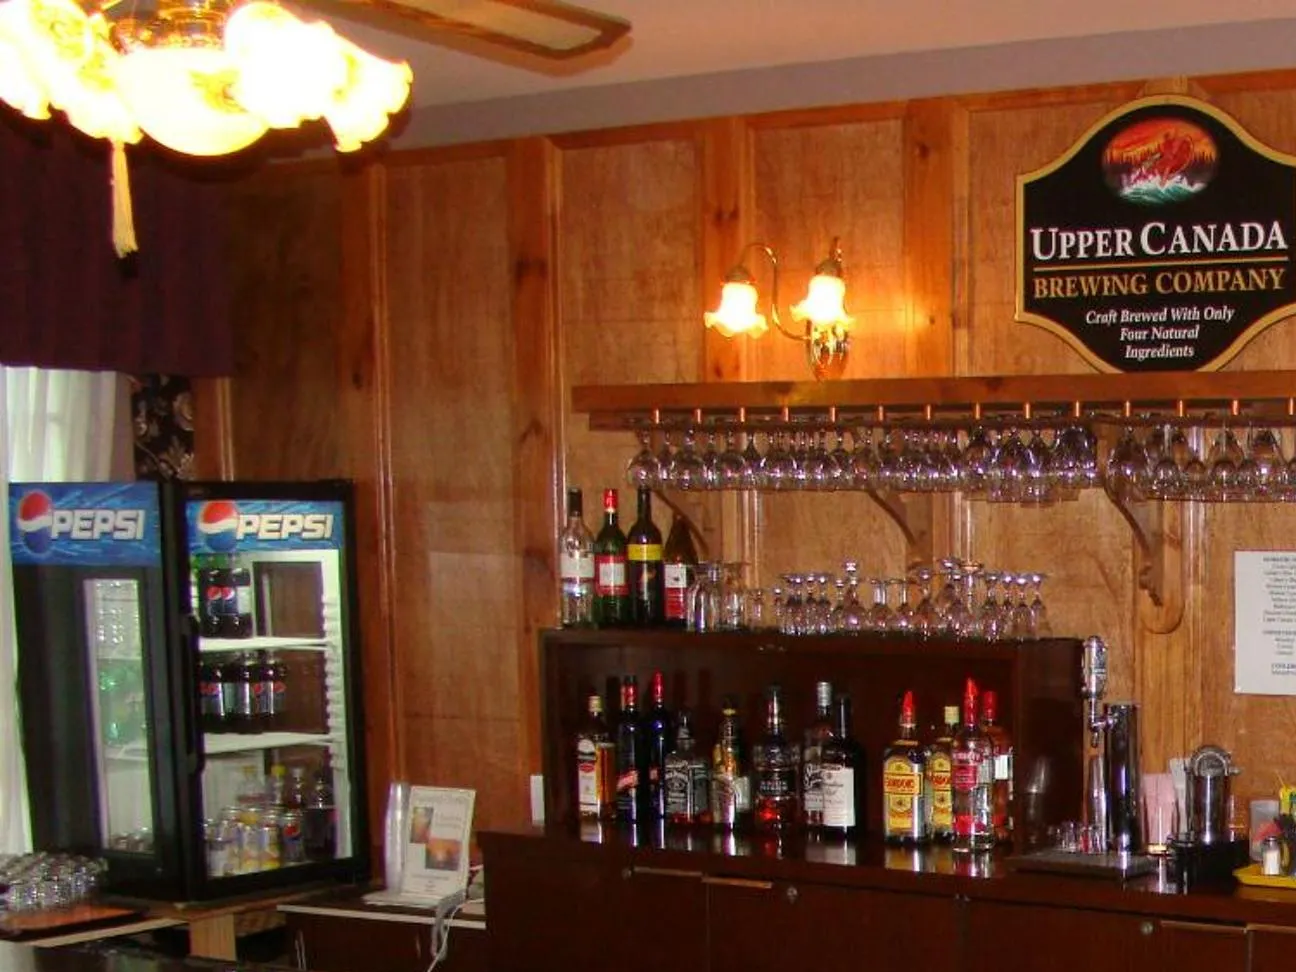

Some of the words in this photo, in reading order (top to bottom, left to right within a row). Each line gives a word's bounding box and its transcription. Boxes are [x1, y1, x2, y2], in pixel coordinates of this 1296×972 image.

[1030, 226, 1135, 260] UPPER
[1140, 220, 1288, 255] CANADA
[1034, 272, 1148, 299] BREWING
[1155, 267, 1286, 294] COMPANY
[1086, 308, 1118, 325] Craft
[1120, 308, 1168, 323] Brewed
[1171, 306, 1201, 321] With
[1203, 305, 1235, 322] Only
[1120, 327, 1148, 341] Four
[1151, 325, 1200, 340] Natural
[1125, 345, 1195, 361] Ingredients
[51, 509, 145, 541] PEPSI
[236, 513, 334, 541] PEPSI
